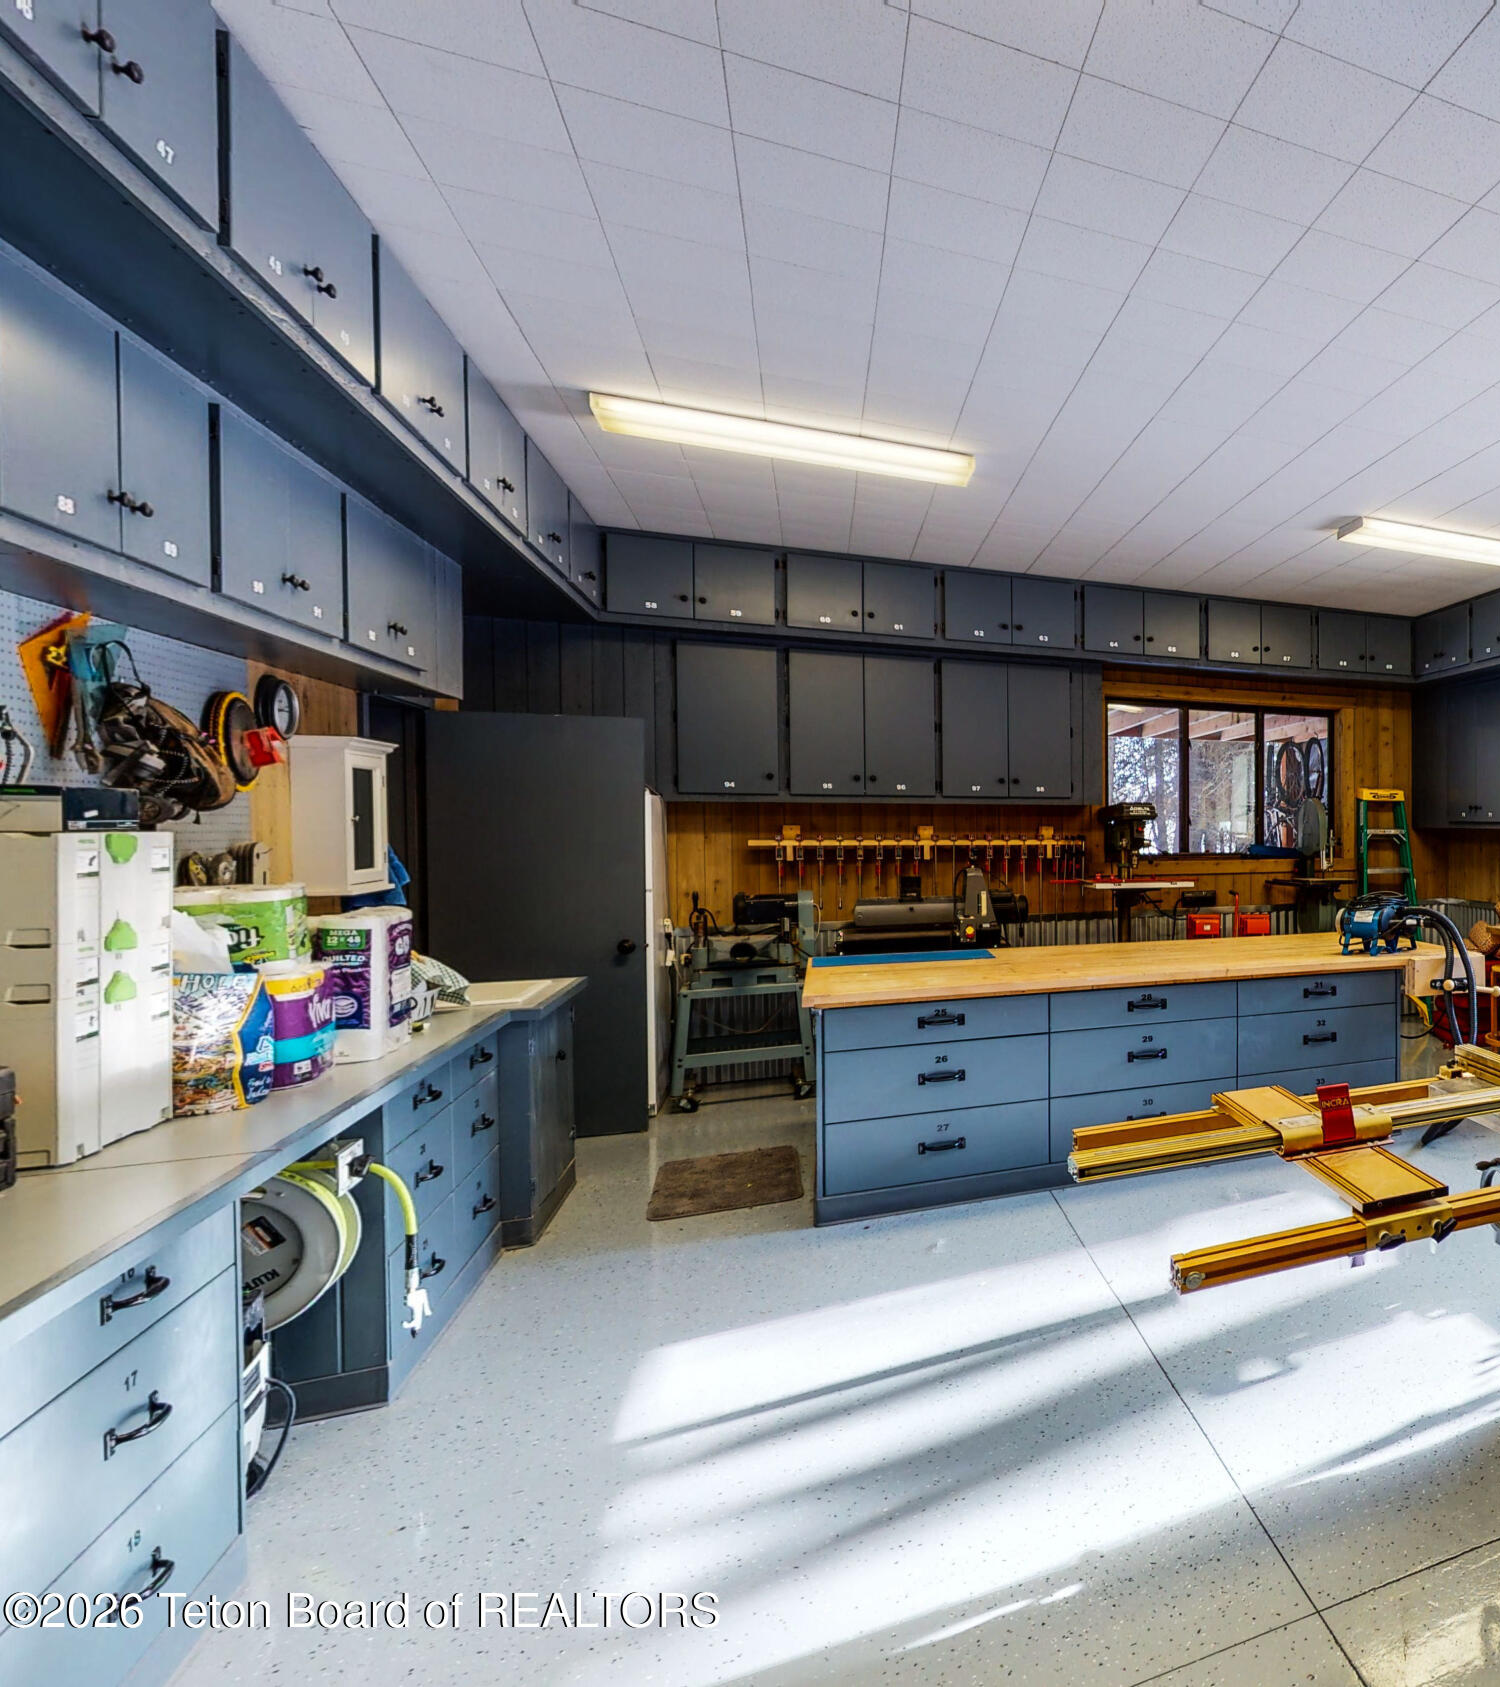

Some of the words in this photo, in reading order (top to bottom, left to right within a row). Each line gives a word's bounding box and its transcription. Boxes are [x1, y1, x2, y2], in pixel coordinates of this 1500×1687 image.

[157, 141, 174, 163] 47
[645, 601, 658, 609] 58
[730, 609, 743, 617] 59
[819, 616, 832, 624] 60
[893, 623, 904, 631] 61
[973, 629, 985, 637] 62
[1038, 634, 1049, 642] 63
[327, 935, 339, 944] 12
[322, 954, 366, 962] QUILTED
[180, 974, 247, 993] HOLE
[1141, 993, 1154, 1002] 28
[934, 1008, 948, 1017] 25
[1321, 1097, 1350, 1109] INCRA
[937, 1124, 949, 1132] 27
[125, 1370, 138, 1391] 17
[128, 1530, 140, 1552] 18
